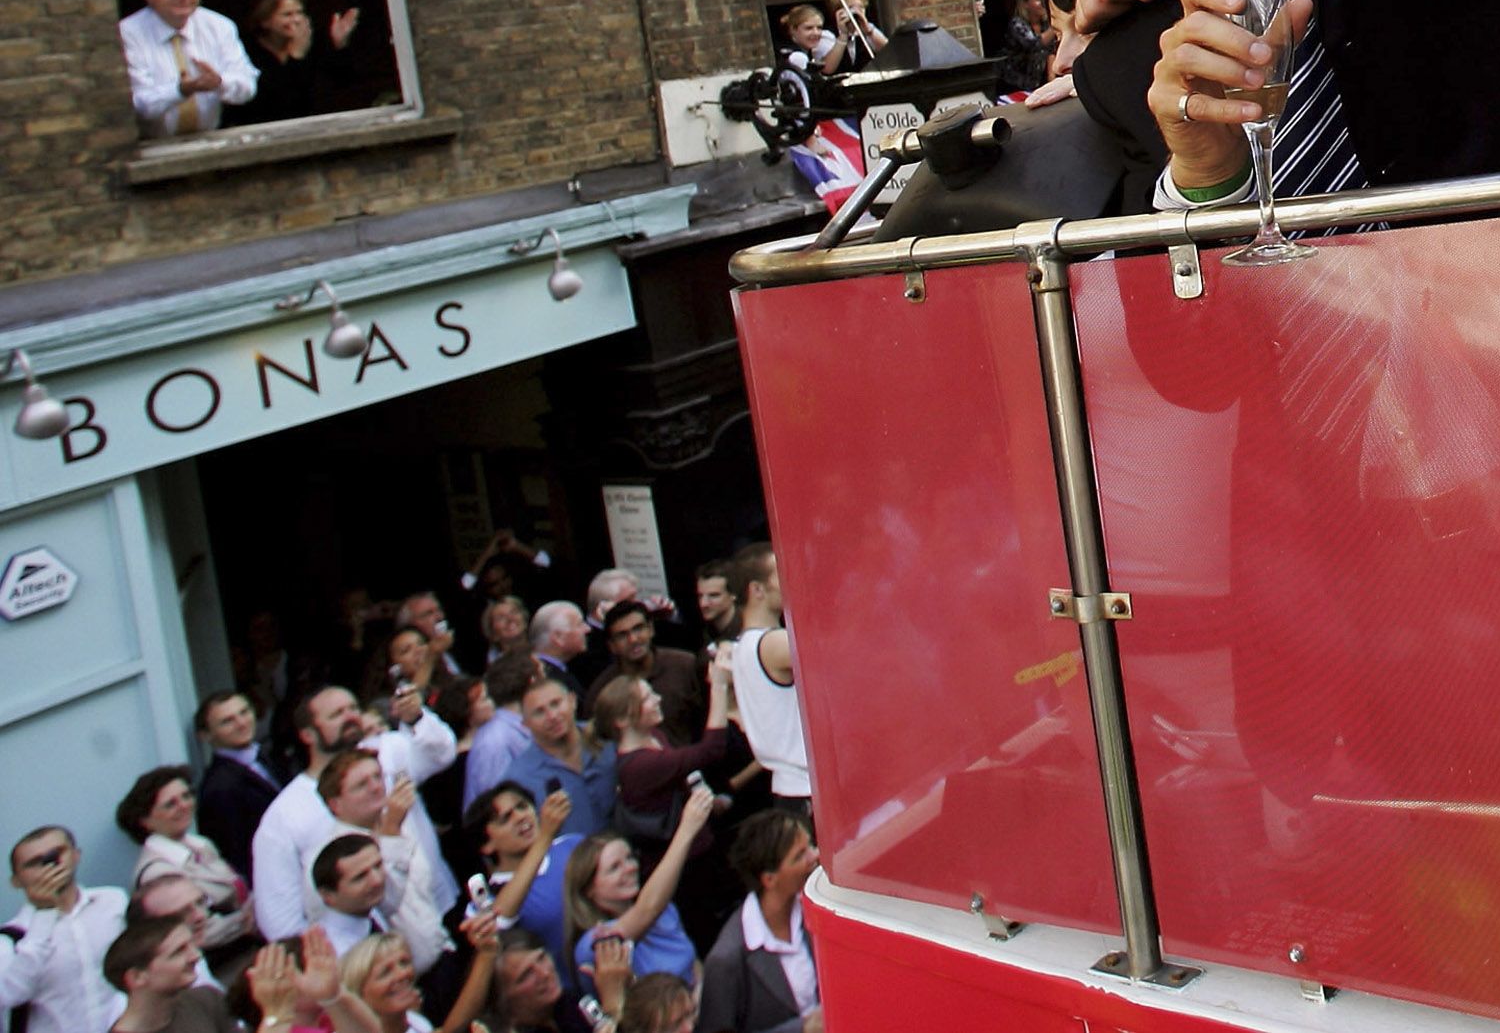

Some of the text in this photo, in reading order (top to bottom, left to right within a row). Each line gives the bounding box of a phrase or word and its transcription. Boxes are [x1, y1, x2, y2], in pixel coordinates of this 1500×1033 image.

[868, 111, 918, 129] Ye Olde
[59, 301, 471, 464] BONAS
